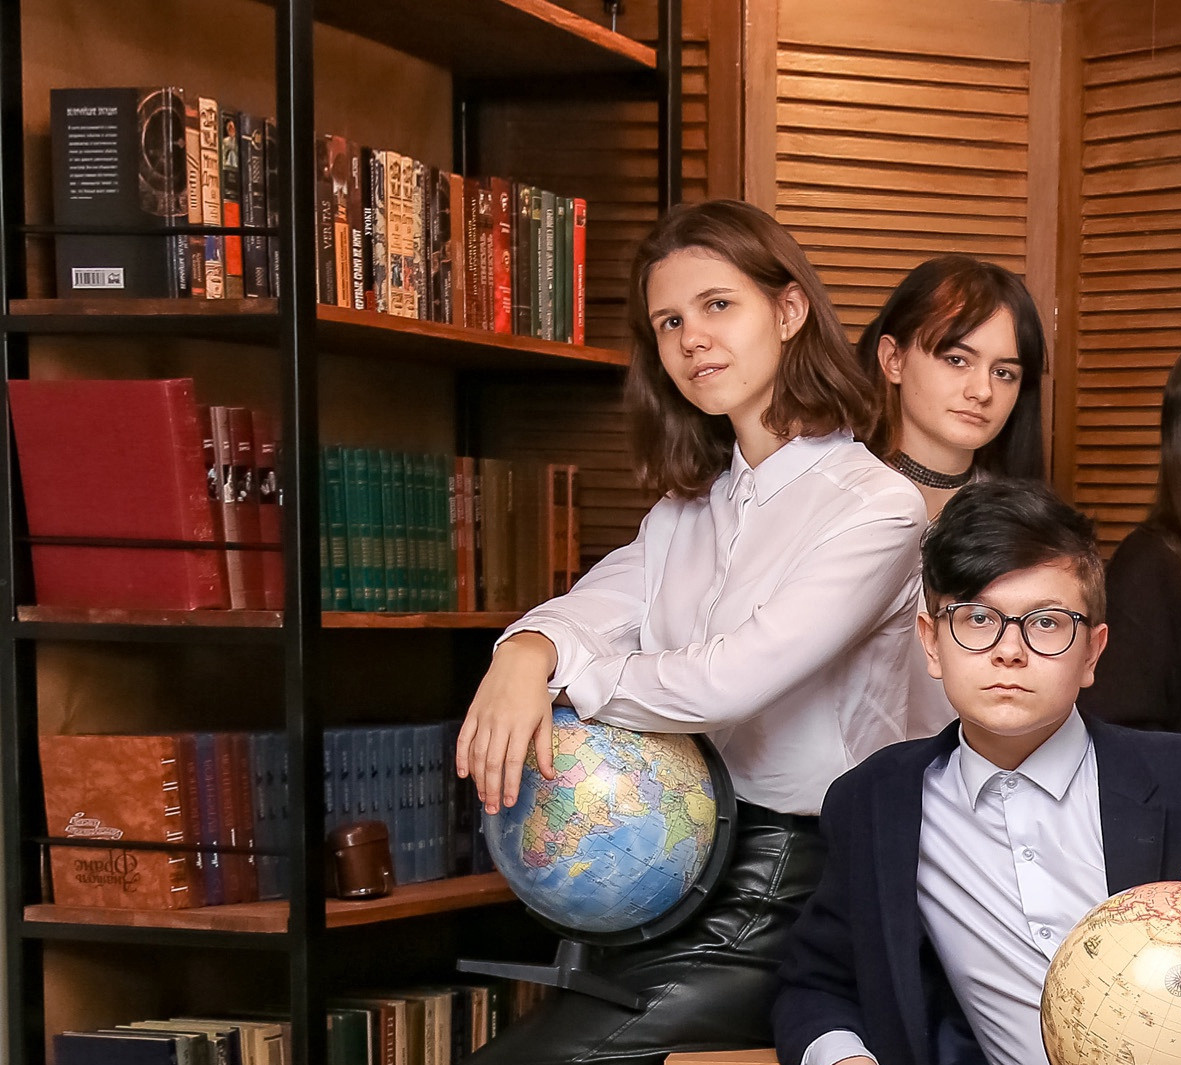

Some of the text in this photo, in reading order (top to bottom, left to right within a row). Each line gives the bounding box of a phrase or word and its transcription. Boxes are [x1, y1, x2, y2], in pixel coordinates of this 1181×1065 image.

[321, 201, 332, 249] VERITAS
[364, 207, 373, 236] УРОКИ
[353, 248, 362, 258] НЕ
[74, 850, 138, 876] Франс
[75, 872, 141, 893] Анатоль
